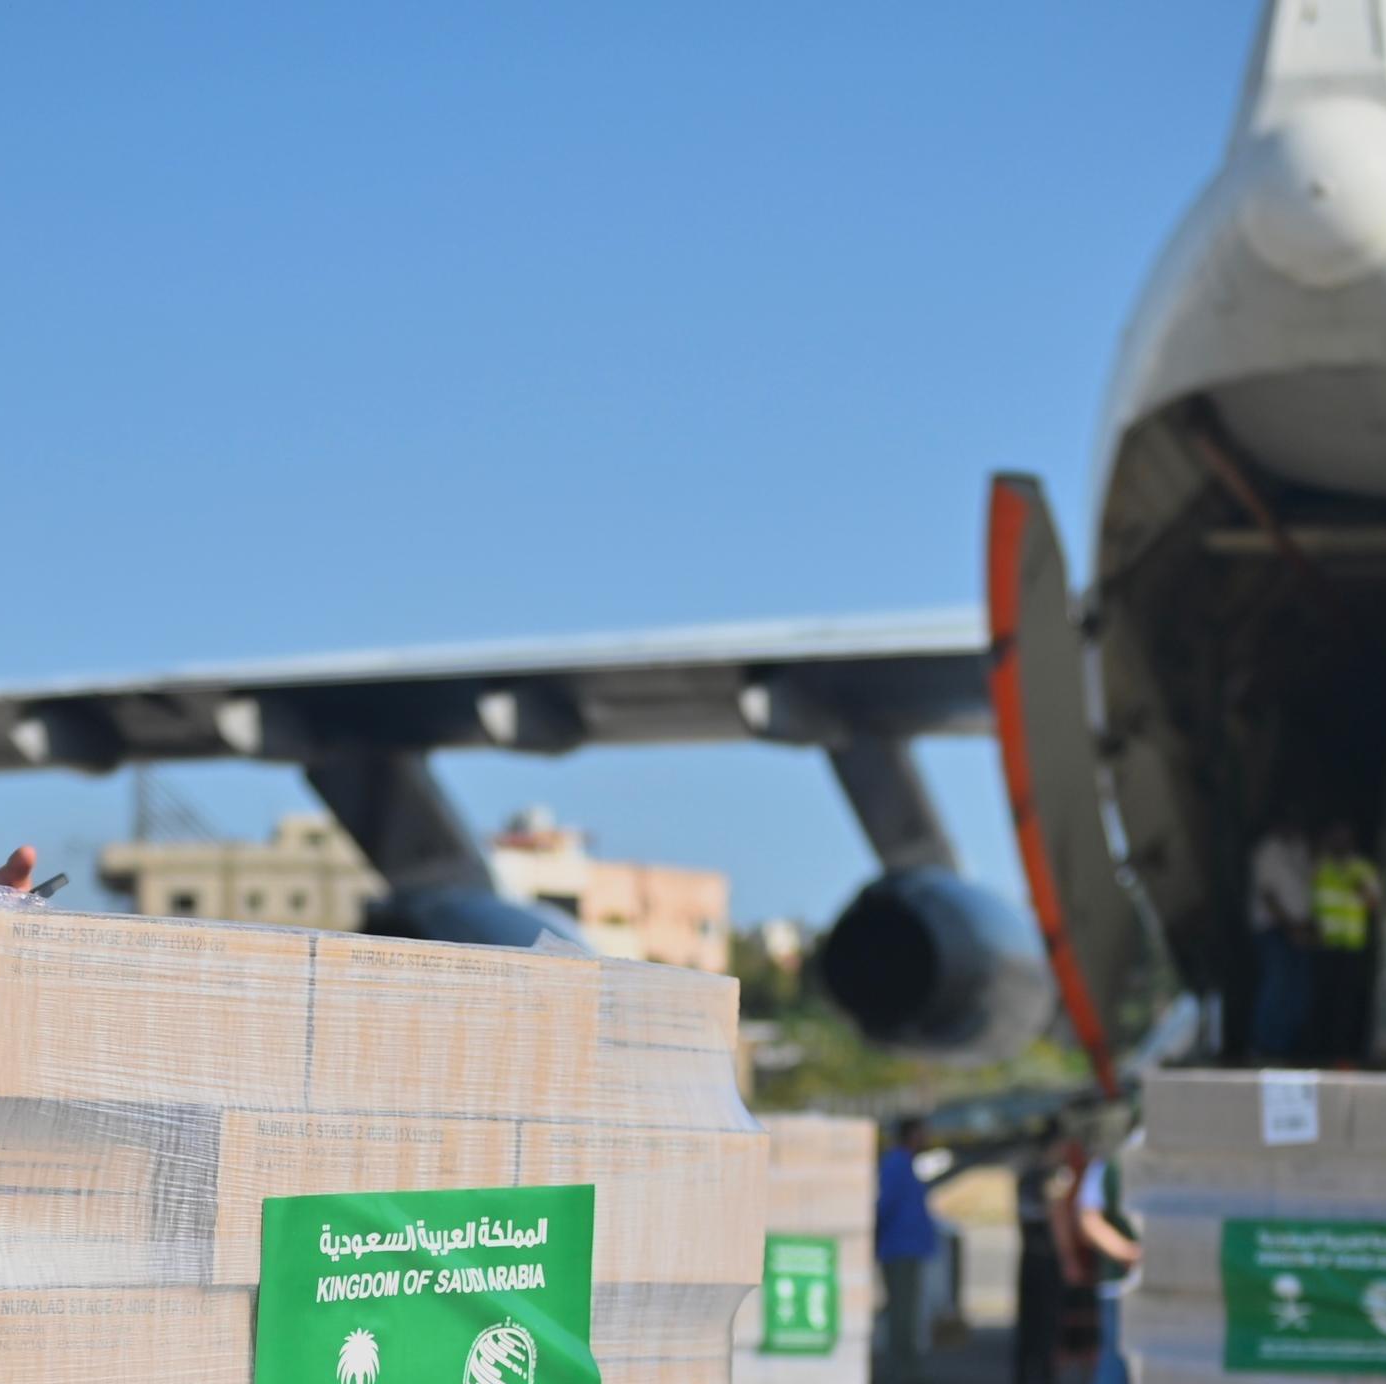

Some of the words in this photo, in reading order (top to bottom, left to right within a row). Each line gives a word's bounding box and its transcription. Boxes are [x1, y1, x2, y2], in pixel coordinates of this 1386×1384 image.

[13, 923, 75, 943] NURALAC
[79, 928, 122, 946] STAGE
[126, 931, 134, 946] 2
[351, 950, 403, 967] NURALAC
[257, 1119, 312, 1138] NURALAC
[316, 1124, 353, 1140] STAGE
[320, 1224, 417, 1262] السعودية
[417, 1219, 476, 1256] العربية
[478, 1217, 548, 1248] المملكة
[316, 1270, 400, 1303] KINGDOM
[403, 1269, 433, 1295] OF
[434, 1268, 488, 1294] SAUDI
[488, 1263, 545, 1291] ARABIA
[0, 1299, 64, 1316] NURALAC
[69, 1299, 112, 1316] STAGE
